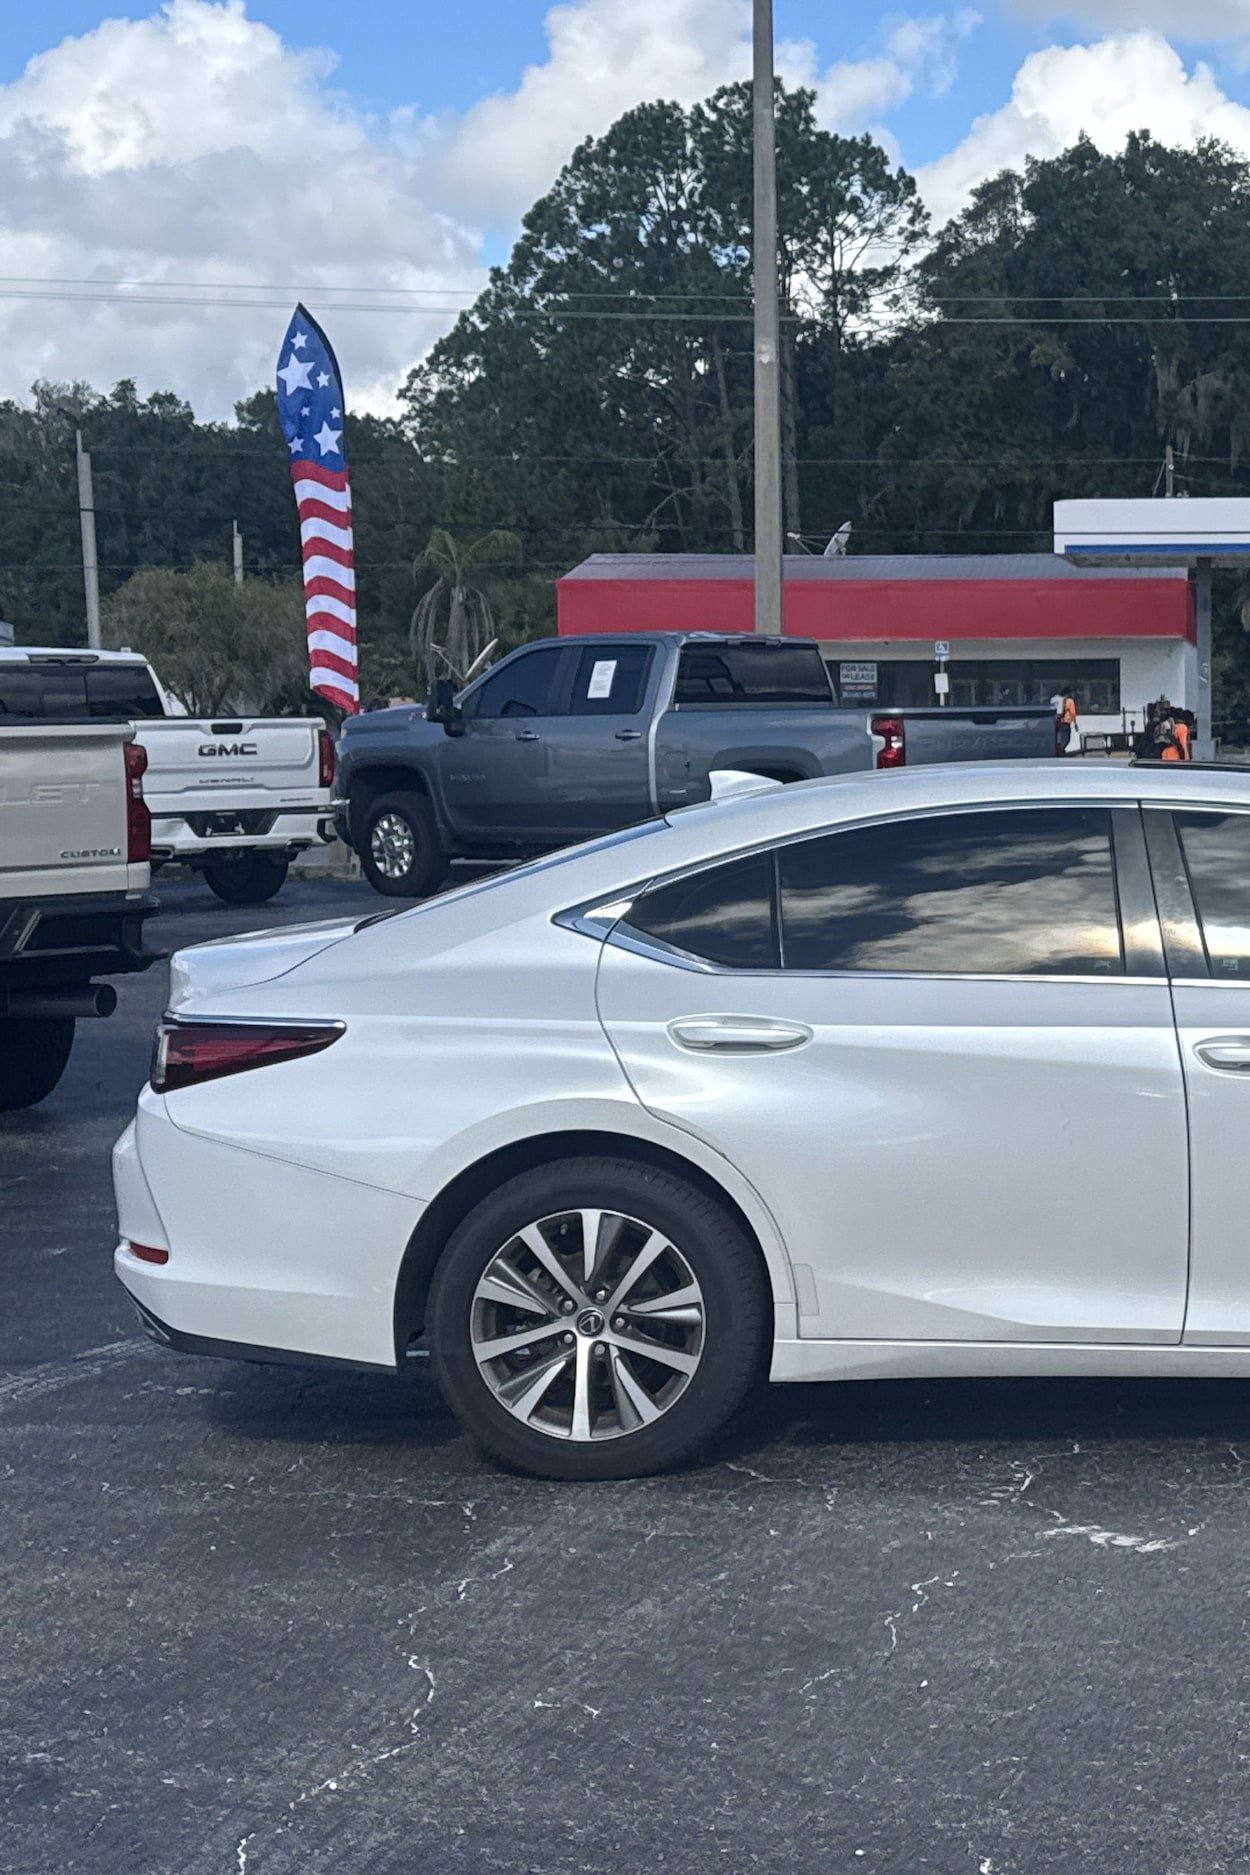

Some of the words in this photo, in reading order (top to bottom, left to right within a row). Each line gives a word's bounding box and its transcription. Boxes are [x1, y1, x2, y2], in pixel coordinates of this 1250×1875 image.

[841, 664, 857, 672] FOR
[858, 664, 875, 672] SALE
[850, 672, 875, 680] LEASE
[198, 743, 258, 757] GMC
[60, 848, 121, 859] CUSTOM
